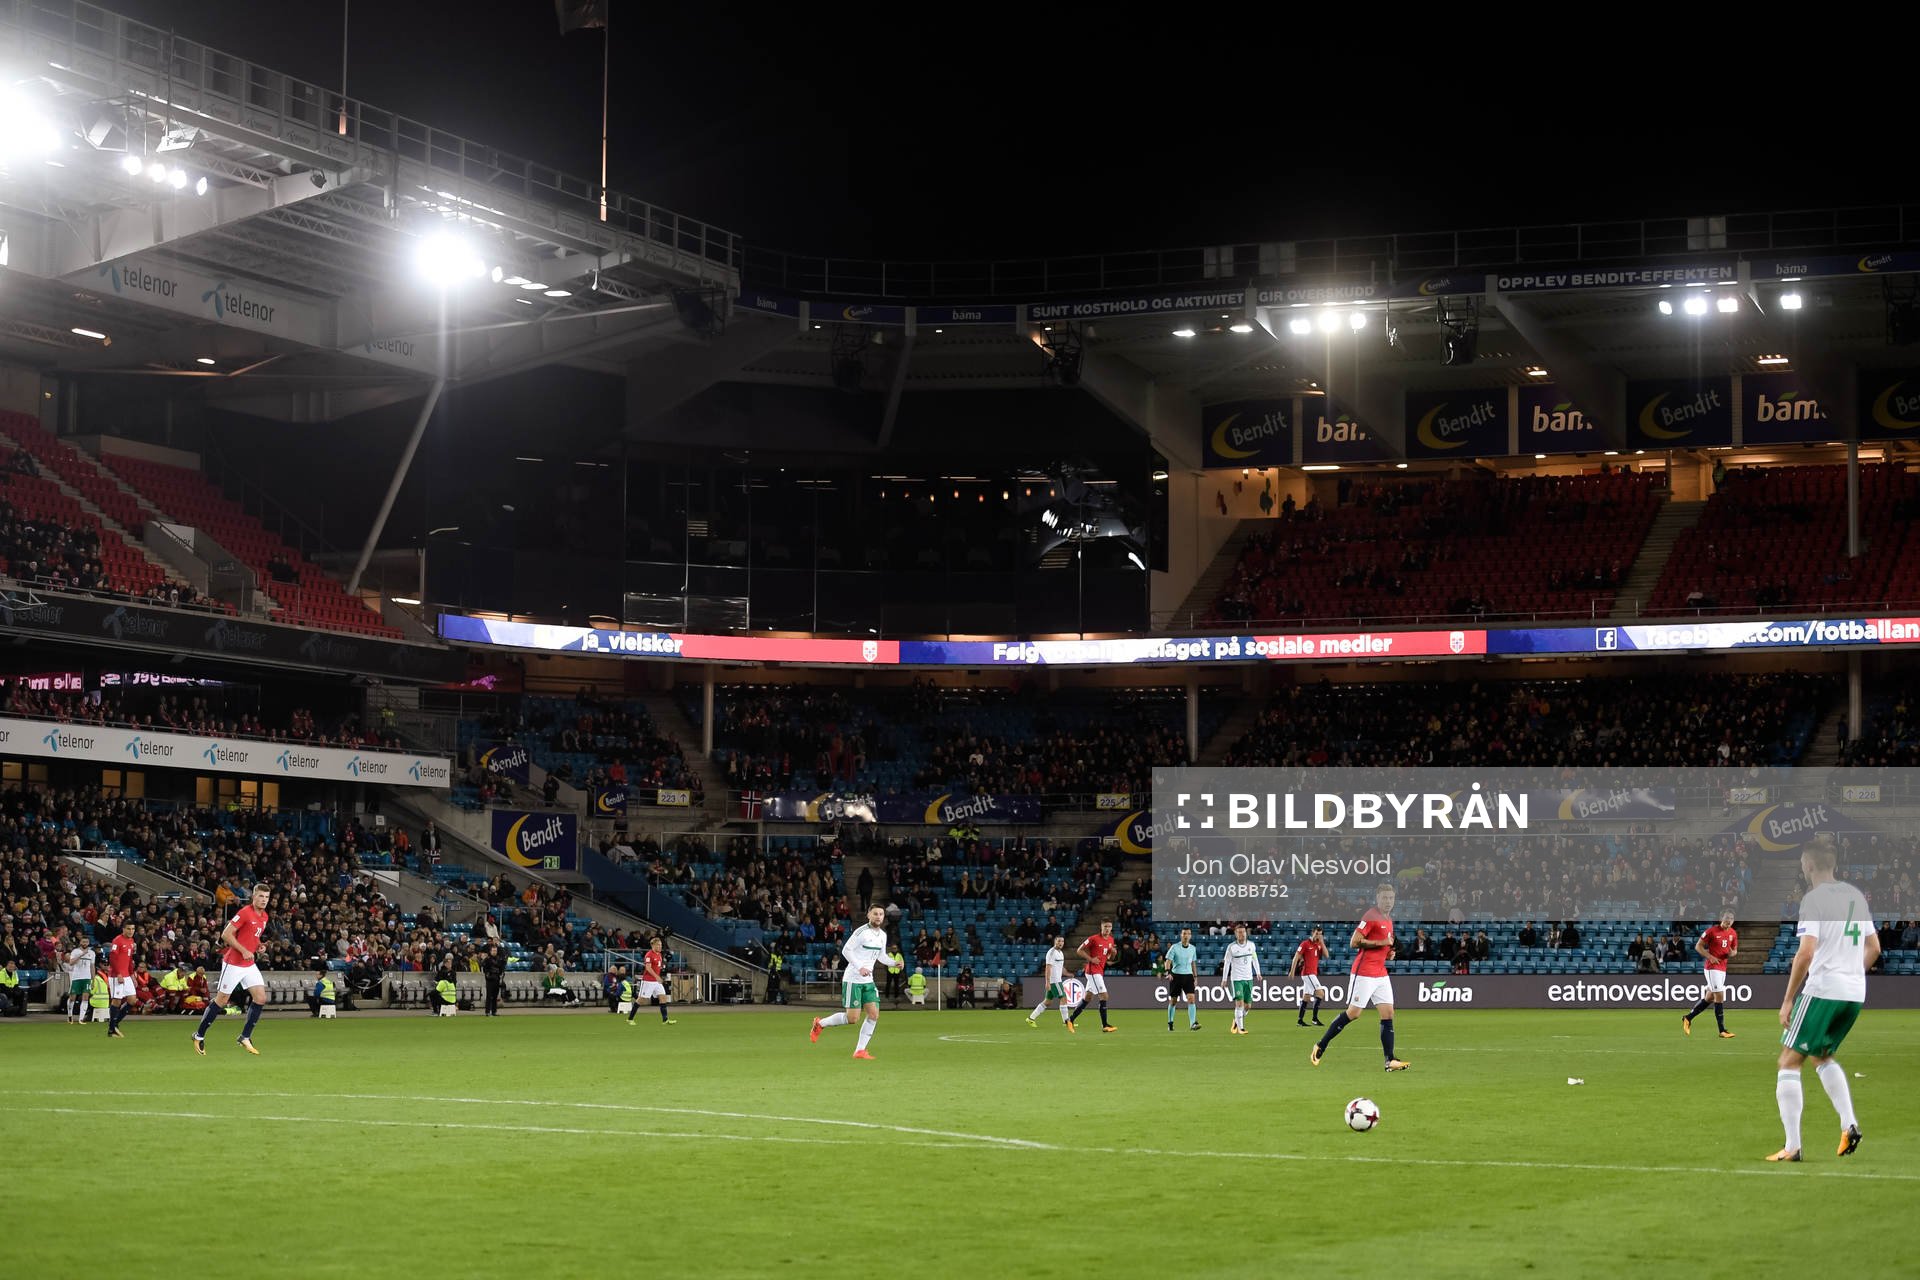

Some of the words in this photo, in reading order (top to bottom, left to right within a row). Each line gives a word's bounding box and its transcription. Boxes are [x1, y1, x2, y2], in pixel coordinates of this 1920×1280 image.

[123, 266, 178, 297] telenor
[1499, 274, 1566, 288] OPPLEV
[1571, 266, 1732, 285] BENDIT-EFFEKTEN
[225, 292, 275, 323] telenor
[1032, 305, 1070, 318] SUNT
[1073, 299, 1148, 315] KOSTHOLD
[1152, 298, 1172, 309] OG
[1176, 293, 1244, 307] AKTIVITET
[1258, 290, 1283, 302] GIR
[1287, 286, 1375, 300] OVERSKUDD
[1438, 401, 1496, 437] Bendit
[1660, 388, 1720, 427] Bendit
[1757, 394, 1827, 422] bam
[1232, 411, 1287, 446] Bendit
[993, 642, 1040, 664] Følg
[1215, 636, 1240, 659] på
[1245, 636, 1314, 656] sosiale
[1320, 635, 1392, 654] medier
[58, 734, 95, 750] telenor
[140, 742, 174, 756] telenor
[217, 748, 249, 764] telenor
[289, 754, 320, 769] telenor
[359, 760, 388, 774] telenor
[420, 764, 447, 779] telenor
[661, 795, 676, 803] 223
[945, 794, 997, 823] Bendit
[1579, 788, 1631, 818] Bendit
[1859, 791, 1876, 799] 228
[522, 816, 563, 852] Bendit
[1134, 812, 1181, 842] Bendi
[1769, 805, 1828, 839] Bendit
[1844, 901, 1861, 946] 4
[1418, 982, 1473, 1002] bama
